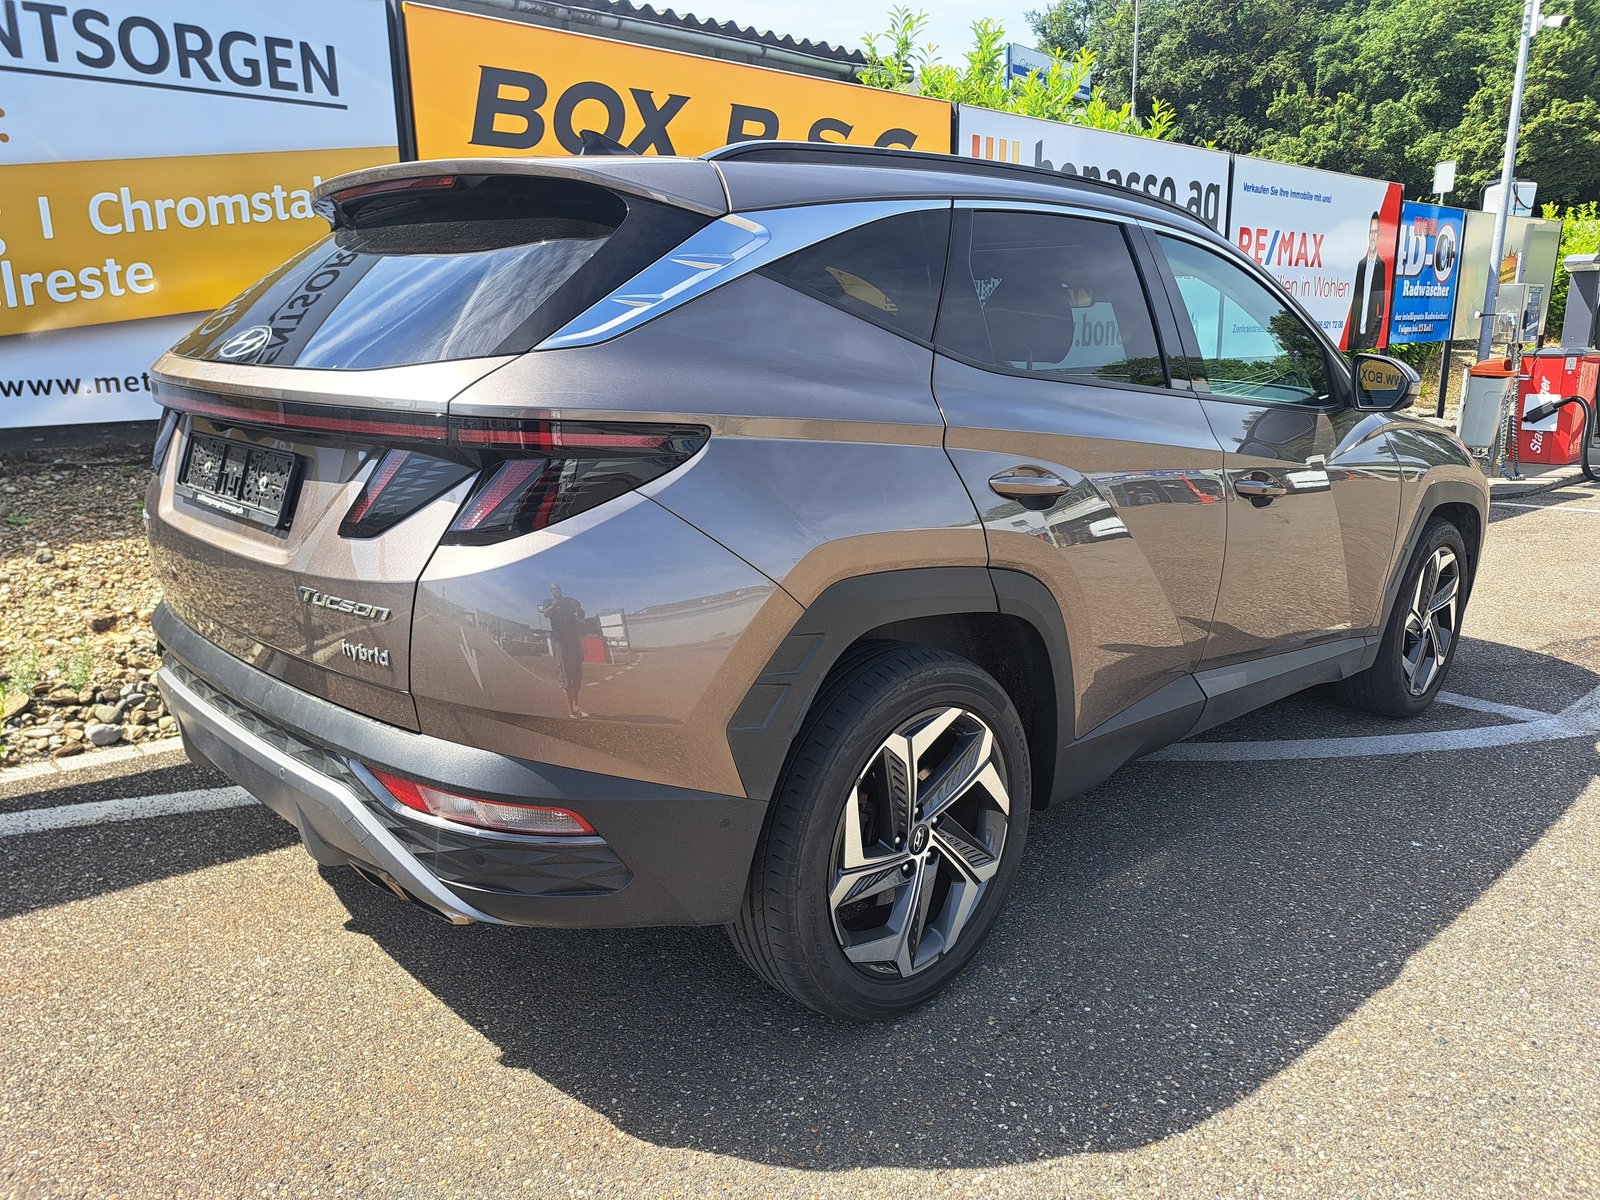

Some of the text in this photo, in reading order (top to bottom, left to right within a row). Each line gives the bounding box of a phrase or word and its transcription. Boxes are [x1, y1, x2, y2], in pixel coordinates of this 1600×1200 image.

[468, 65, 691, 156] BOX
[1243, 181, 1269, 195] Verkaufen
[1270, 185, 1279, 196] Sie
[1280, 188, 1289, 198] Ihre
[1290, 189, 1313, 201] Immobilie
[88, 175, 321, 236] Chromsta
[1238, 226, 1325, 269] RE/MAX
[1300, 276, 1310, 297] in
[1313, 276, 1350, 298] Wohlen
[1402, 279, 1450, 298] Radwäscher
[1402, 312, 1424, 322] intelligente
[341, 638, 390, 666] hybrid
